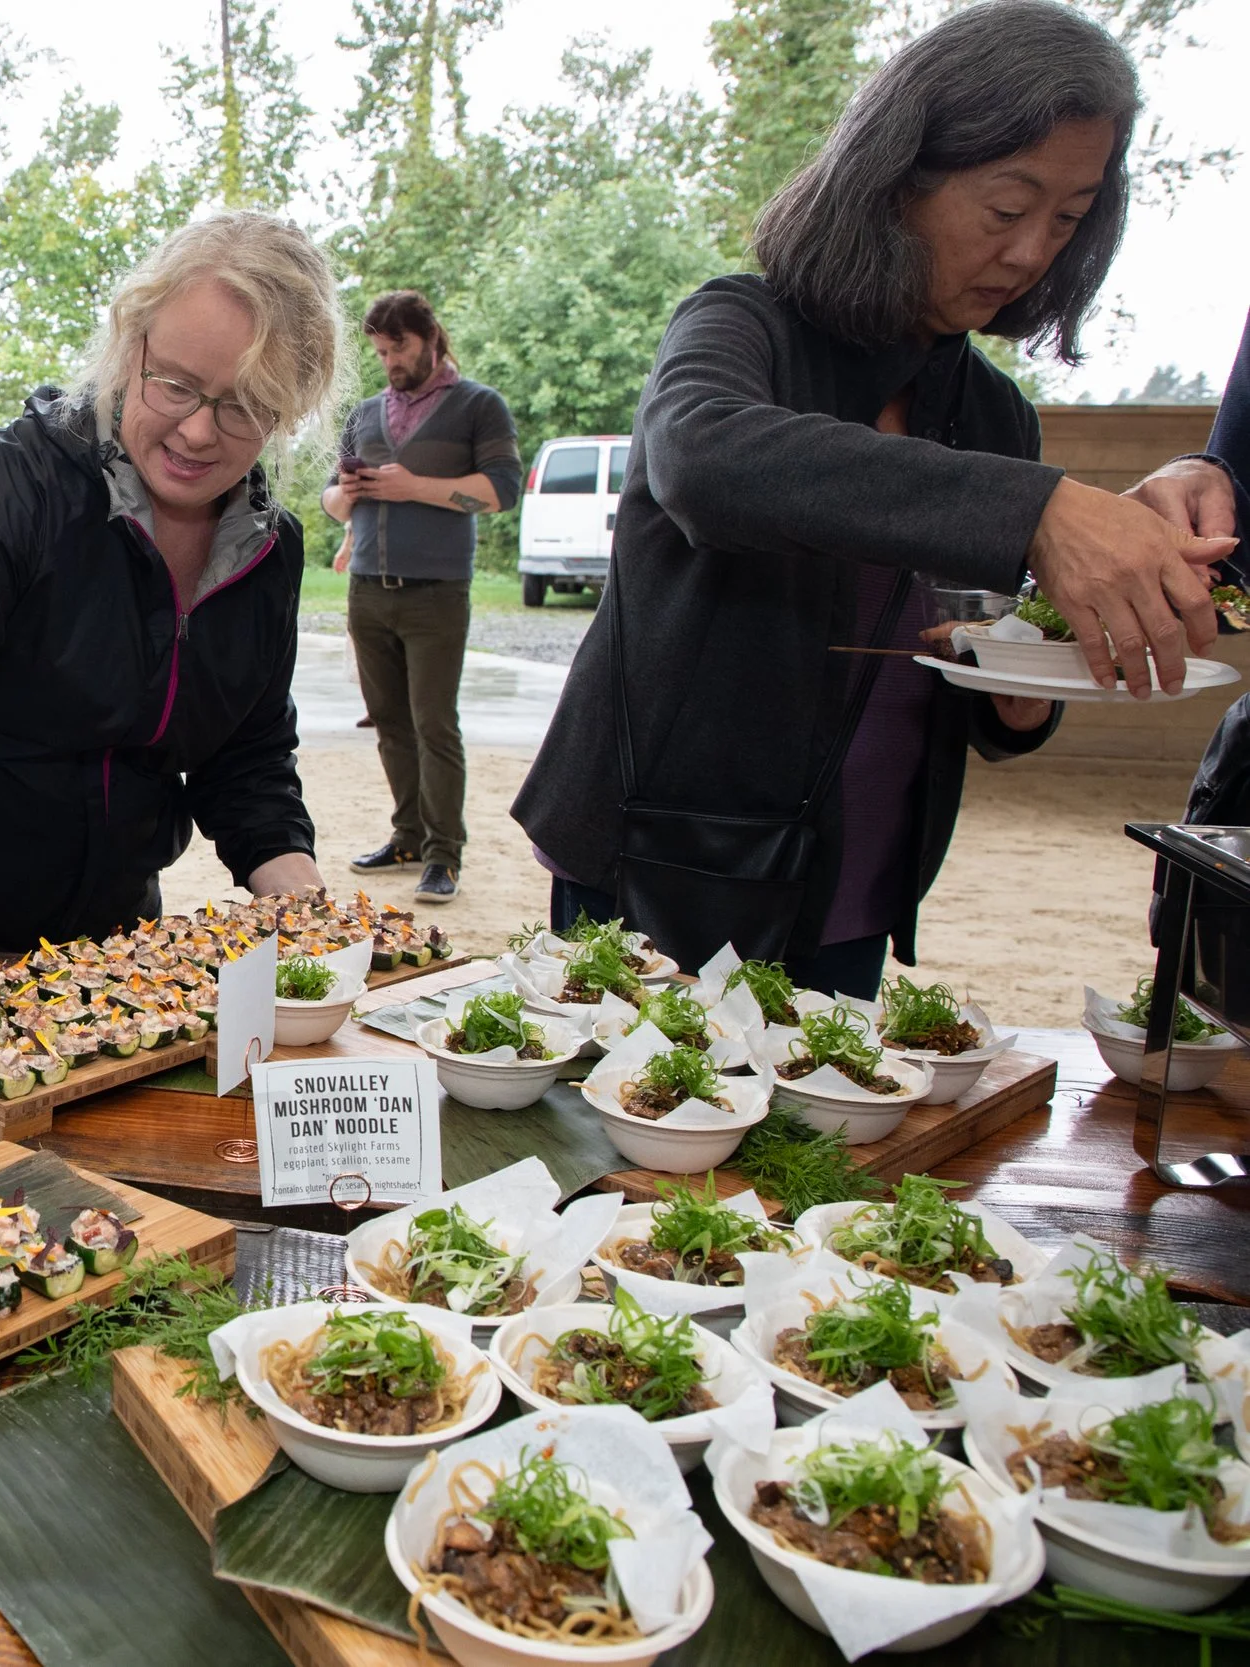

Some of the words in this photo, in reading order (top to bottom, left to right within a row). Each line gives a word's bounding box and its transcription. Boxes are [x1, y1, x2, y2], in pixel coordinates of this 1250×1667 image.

[294, 1075, 390, 1095] SNOVALLEY
[274, 1097, 368, 1118] MUSHROOM
[335, 1118, 399, 1135] NOODLE
[288, 1143, 325, 1155] roasted
[327, 1141, 367, 1156] Skylight
[370, 1141, 401, 1152] Farms
[283, 1158, 328, 1170] eggplant,
[331, 1156, 372, 1167] scallion,
[375, 1156, 411, 1165] sesame
[329, 1183, 344, 1193] oy,
